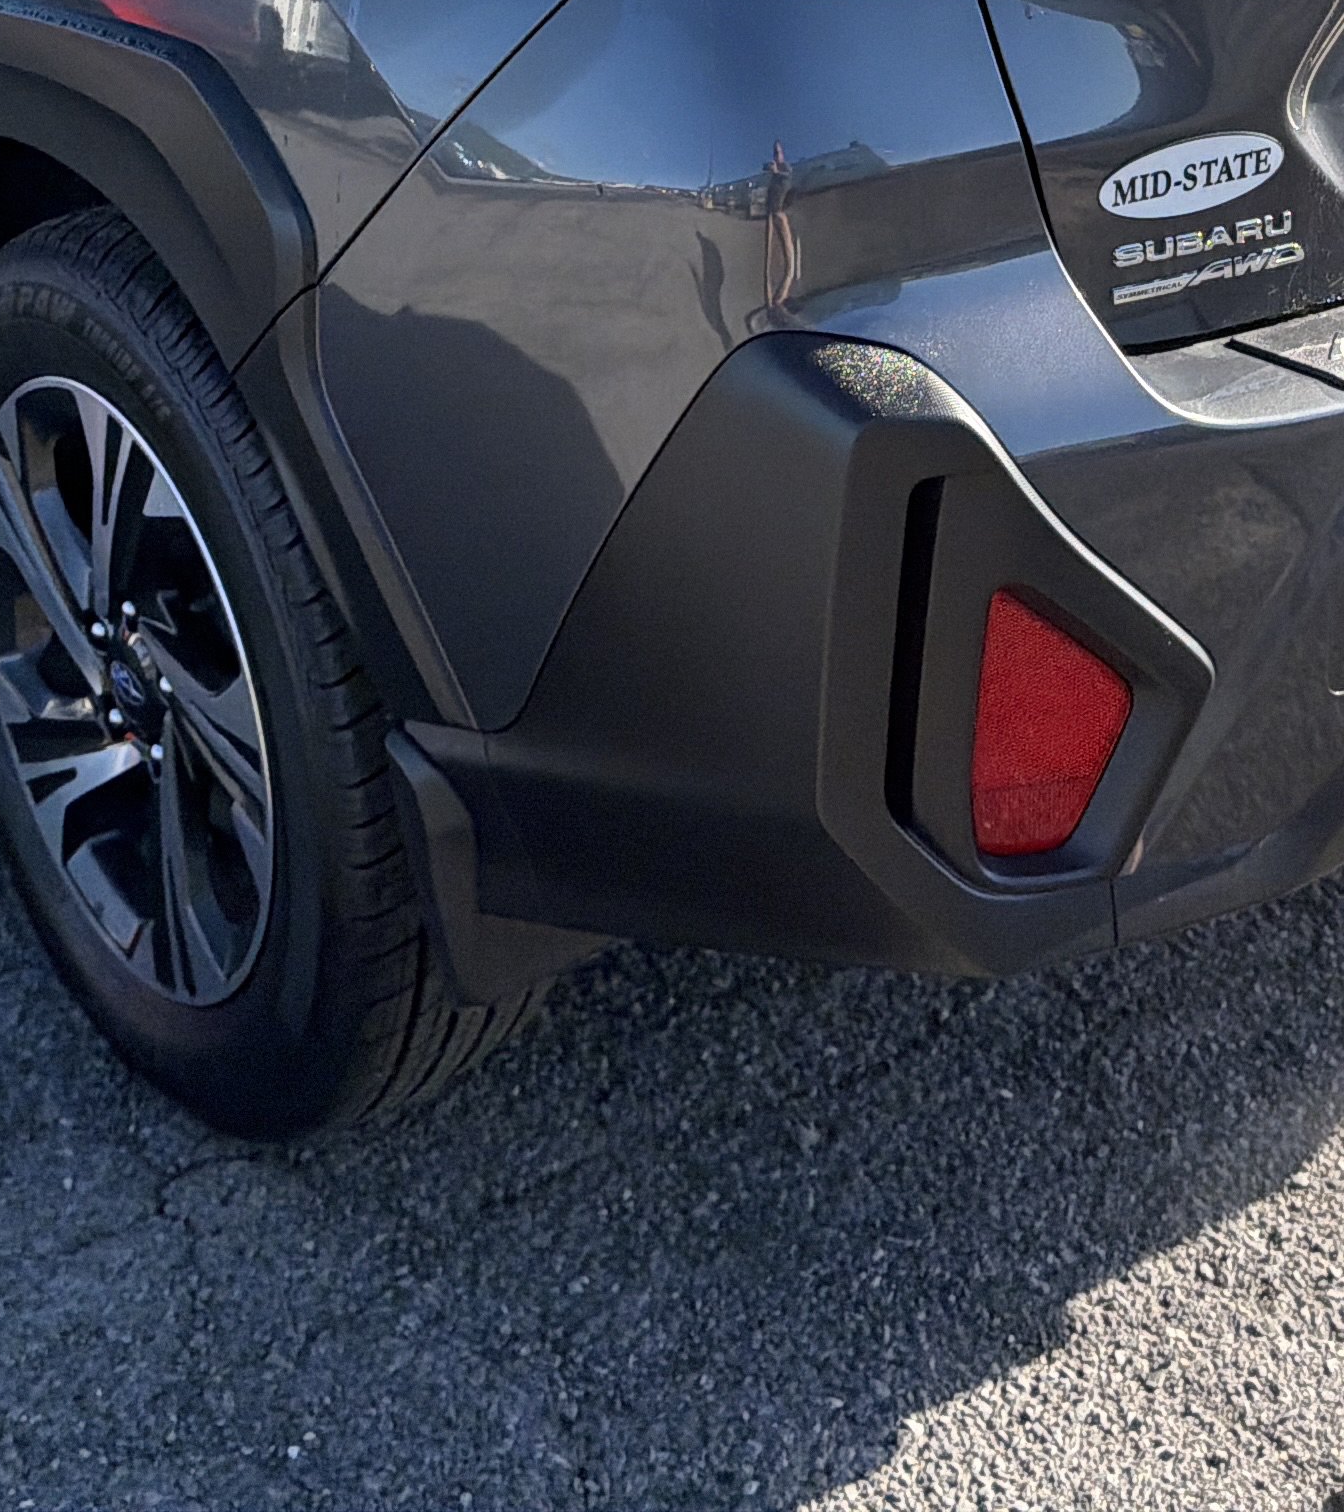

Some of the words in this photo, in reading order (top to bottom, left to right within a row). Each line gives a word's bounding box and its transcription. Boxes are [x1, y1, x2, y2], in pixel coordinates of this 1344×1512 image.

[1111, 147, 1272, 207] MID-STATE
[1112, 209, 1293, 268] SUBARU
[1115, 281, 1184, 302] SYMMETRICAL
[1188, 242, 1306, 287] AWD
